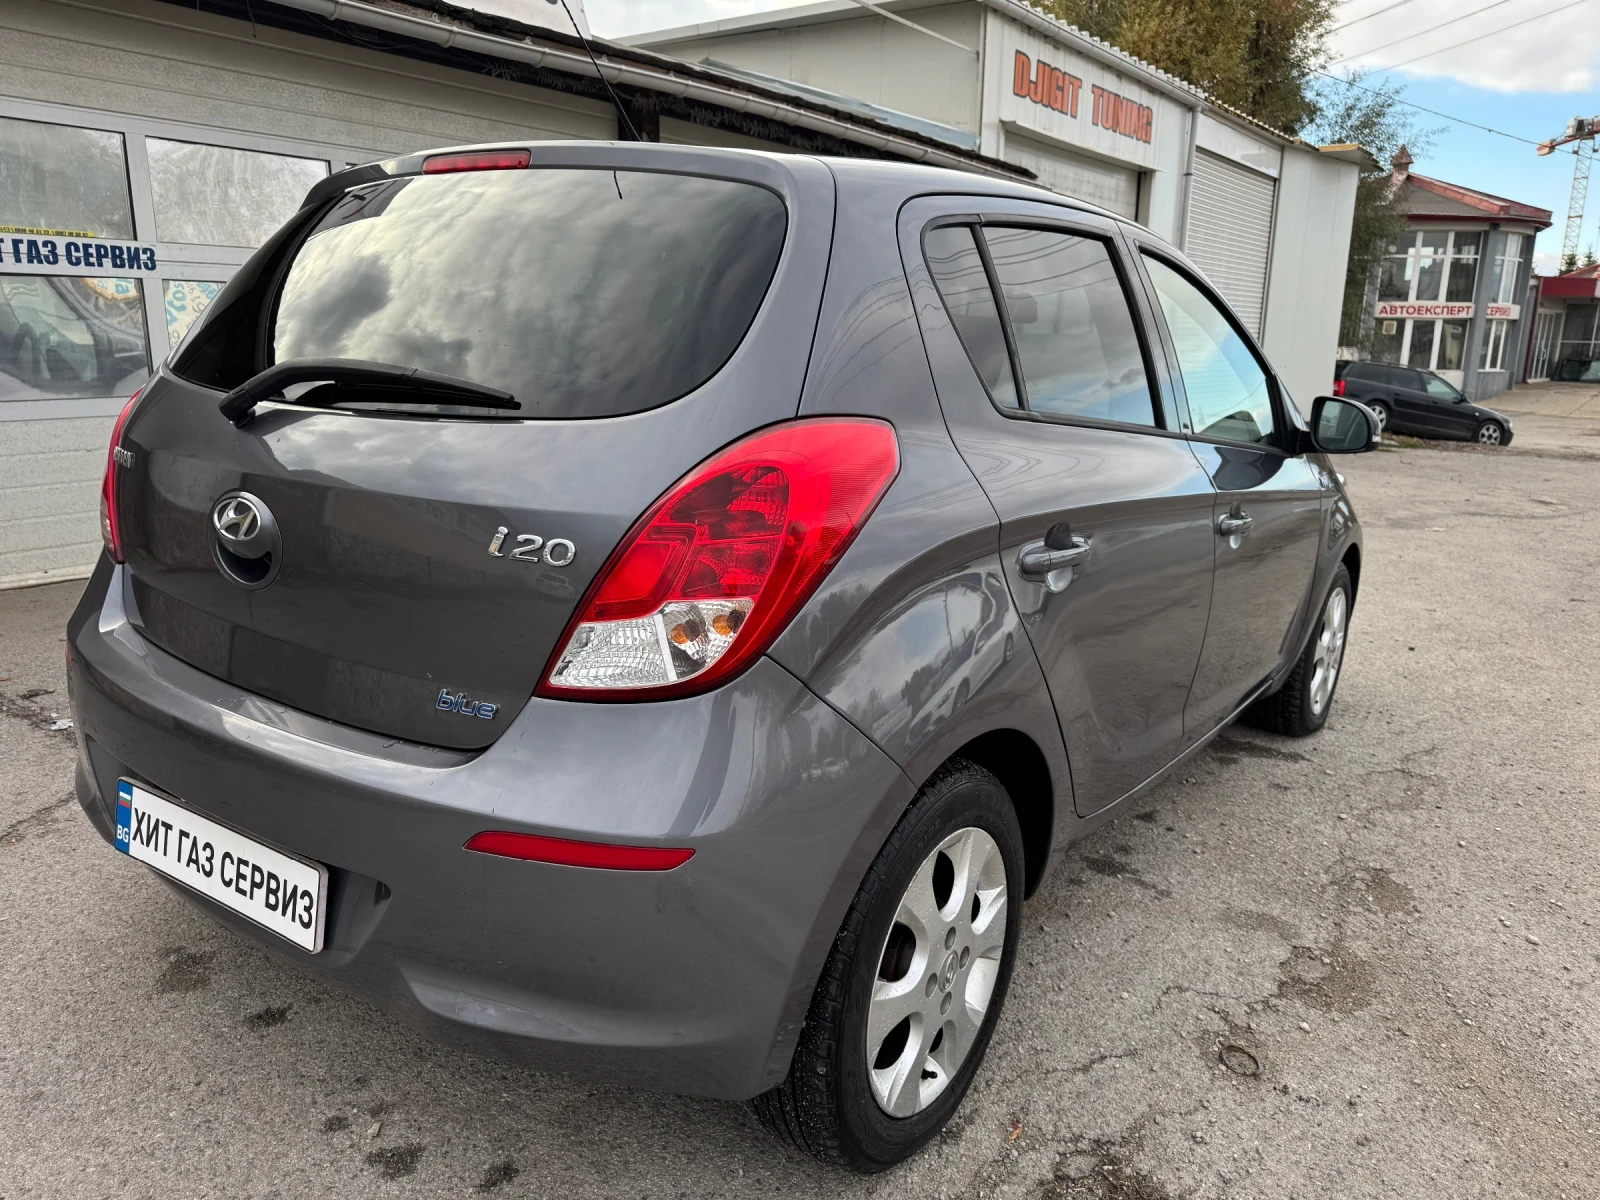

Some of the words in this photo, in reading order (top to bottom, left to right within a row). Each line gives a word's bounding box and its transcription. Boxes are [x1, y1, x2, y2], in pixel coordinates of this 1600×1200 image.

[1013, 49, 1082, 119] DJIGIT
[1092, 84, 1153, 144] TUNING
[11, 238, 59, 265] ГАЗ
[65, 241, 156, 271] СЕРВИЗ
[1379, 305, 1472, 316] АВТОЕКСПЕРТ
[488, 526, 576, 566] i20
[436, 688, 498, 719] blue
[117, 825, 129, 843] BG
[132, 807, 173, 856] ХИТ
[177, 829, 215, 878] ГАЗ
[220, 851, 314, 930] СЕРВИЗ
